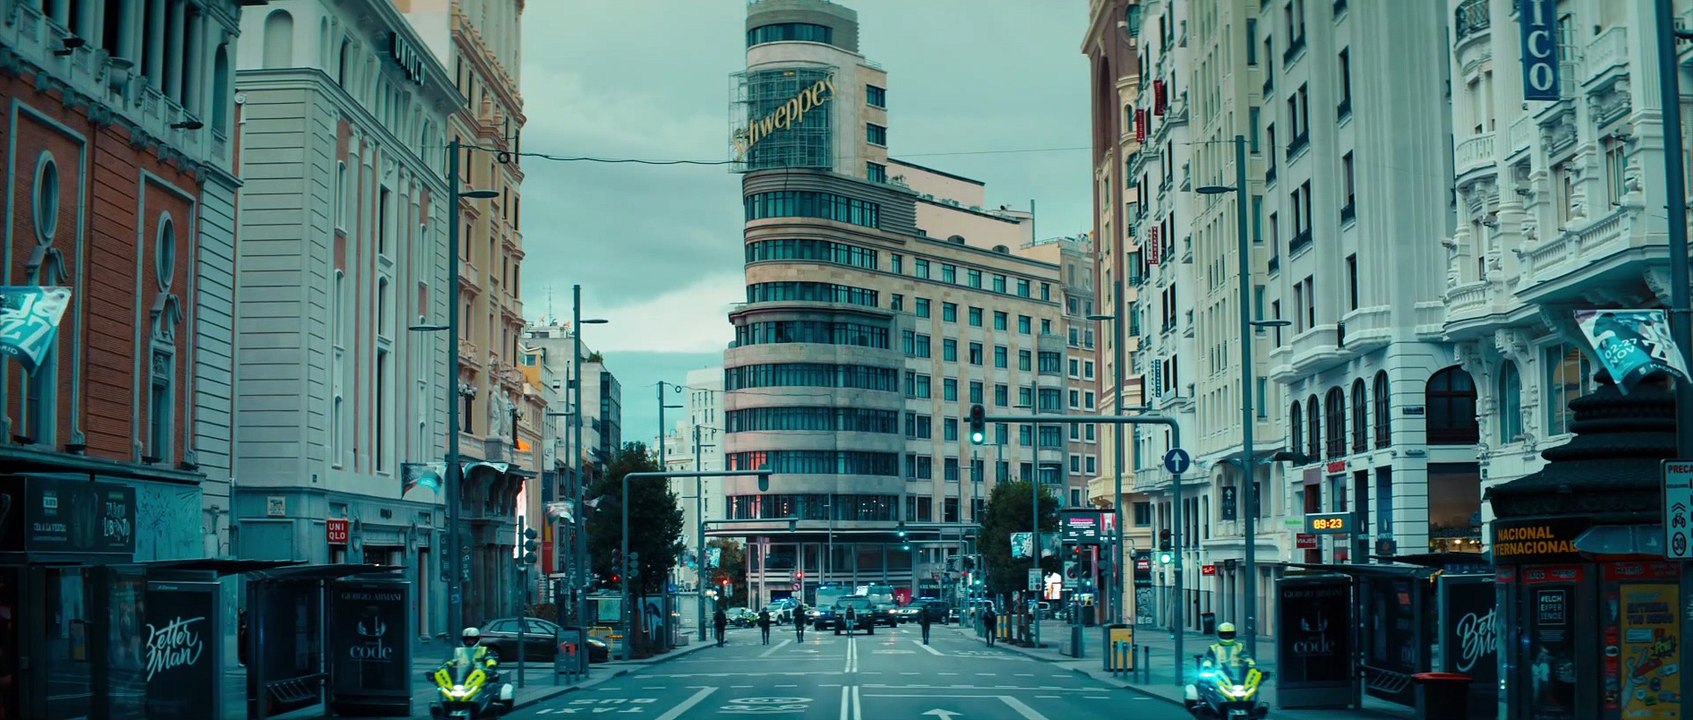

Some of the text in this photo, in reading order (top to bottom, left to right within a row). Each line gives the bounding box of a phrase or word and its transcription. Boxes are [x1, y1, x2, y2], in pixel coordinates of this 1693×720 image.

[390, 32, 428, 87] UNIQLO
[1604, 338, 1638, 359] 02-27
[1609, 346, 1635, 367] NOV
[328, 522, 345, 531] UNI
[1313, 518, 1342, 529] 09:23
[328, 531, 346, 540] QLO
[1498, 525, 1555, 542] NACIONAL
[1674, 537, 1684, 550] 30
[349, 638, 393, 660] code
[1293, 633, 1336, 653] code
